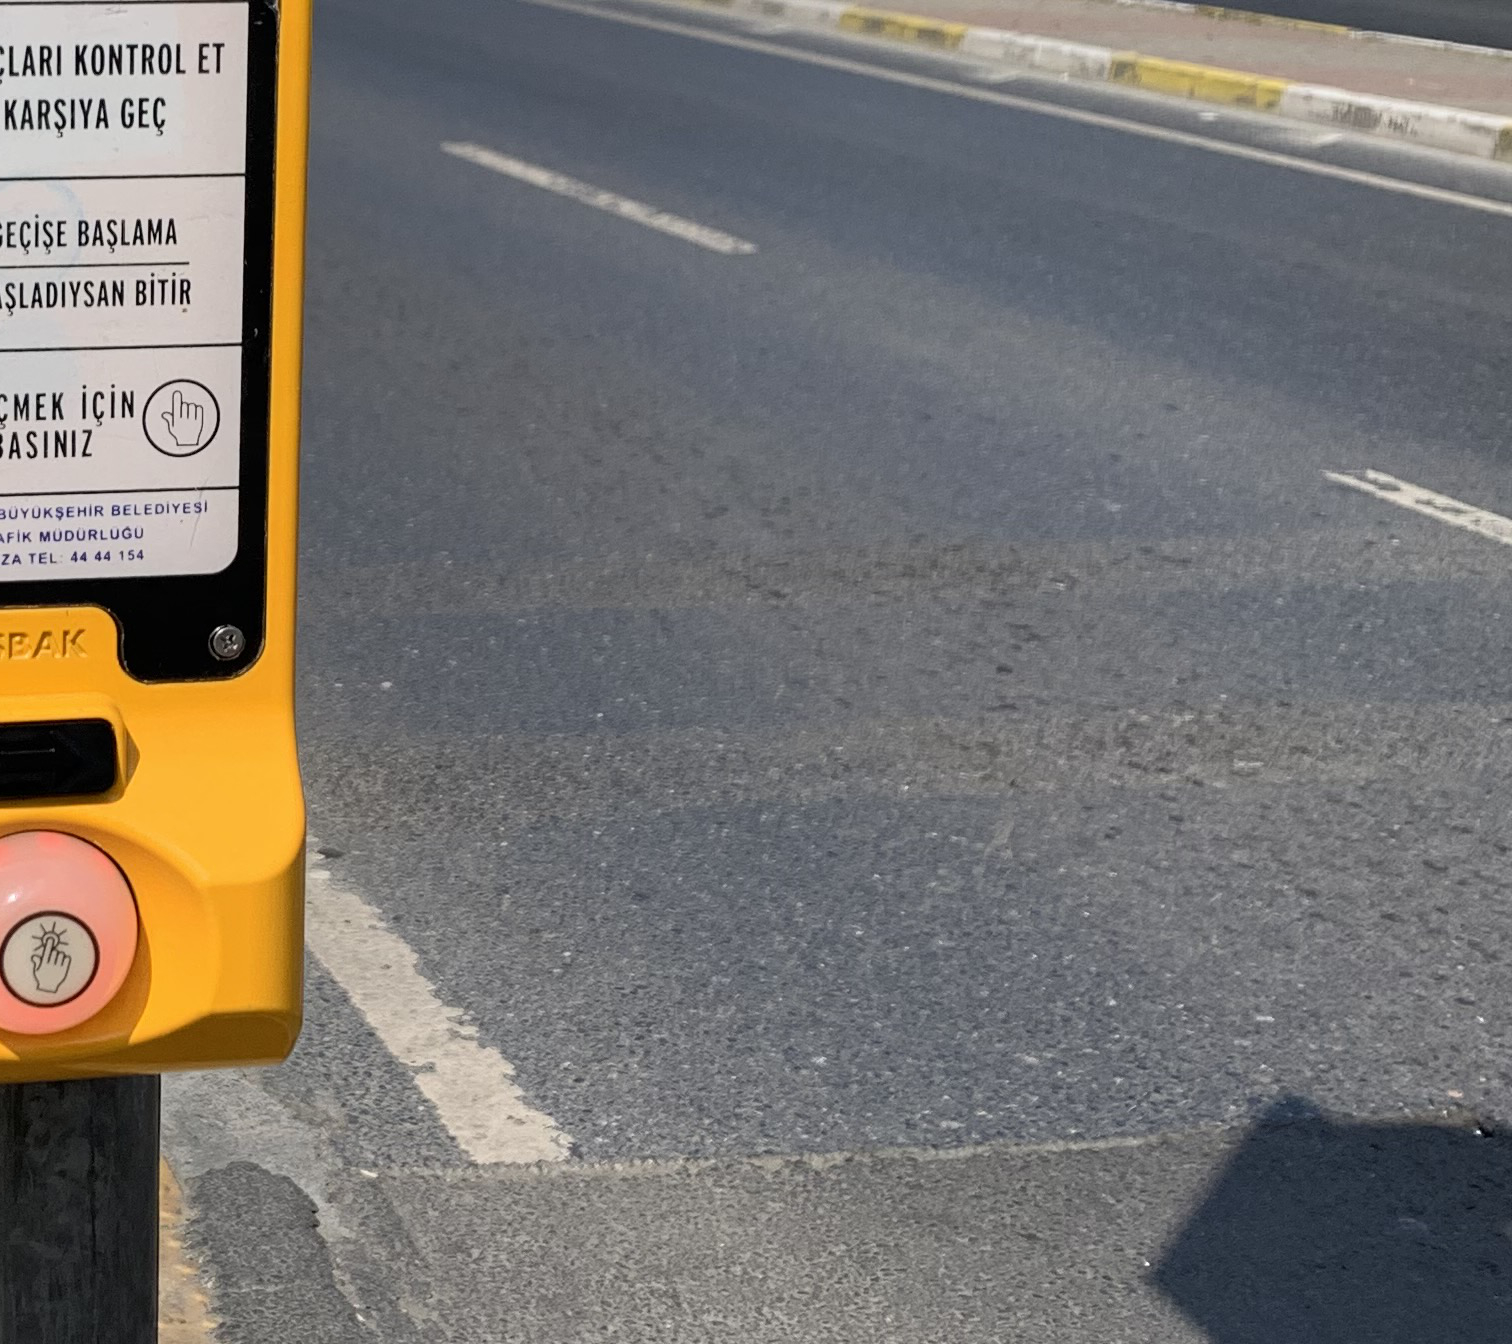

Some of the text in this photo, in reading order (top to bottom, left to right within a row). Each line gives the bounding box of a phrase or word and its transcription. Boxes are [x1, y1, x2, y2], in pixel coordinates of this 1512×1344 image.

[75, 43, 186, 76] KONTROL
[198, 43, 226, 74] ET
[4, 97, 167, 138] KARŞIYA GEÇ
[78, 217, 178, 253] BAŞLAMA
[135, 272, 192, 307] BİTİR
[80, 384, 136, 425] İÇİN
[111, 500, 208, 516] BELEDİYESİ
[39, 525, 144, 543] MÜDÜRLÜĞÜ
[70, 551, 87, 563] 44
[94, 551, 111, 562] 44
[119, 549, 145, 562] 154
